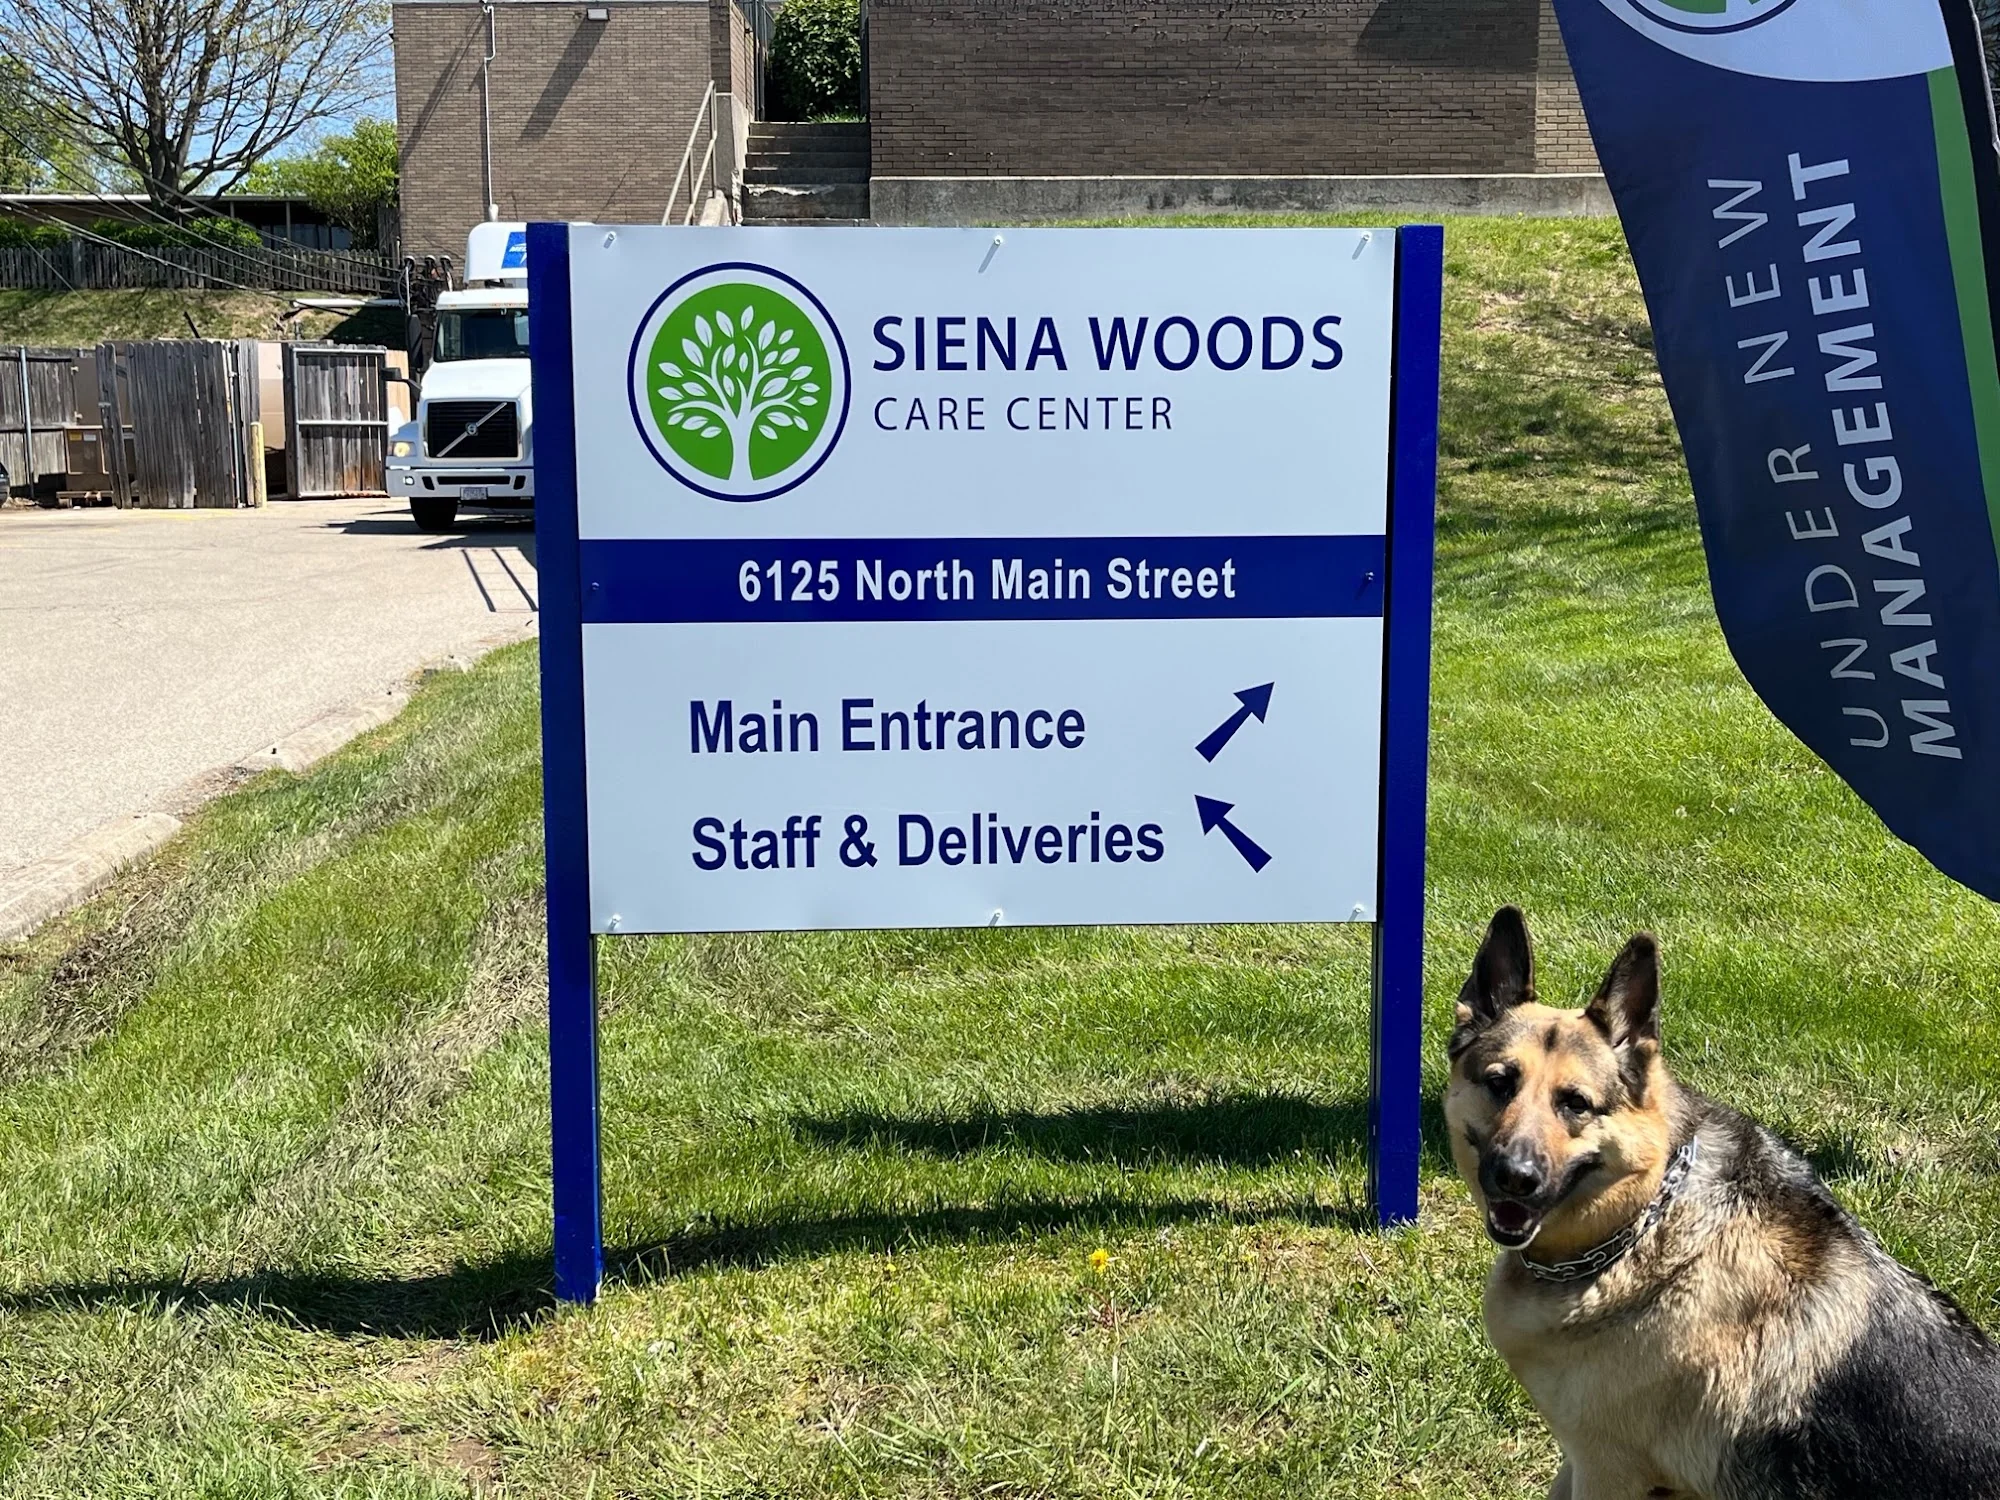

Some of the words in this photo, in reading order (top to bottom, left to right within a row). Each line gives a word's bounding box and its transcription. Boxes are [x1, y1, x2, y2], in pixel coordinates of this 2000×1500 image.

[1707, 178, 1796, 385] NEW
[872, 315, 1068, 372] SIENA
[1087, 315, 1343, 372] WOODS
[874, 396, 985, 431] CARE
[1006, 396, 1172, 431] CENTER
[1787, 152, 1963, 760] MANAGEMENT
[739, 559, 840, 602] 6125
[856, 559, 974, 601] North
[992, 558, 1090, 600] Main
[1106, 557, 1237, 599] Street
[1767, 443, 1889, 749] UNDER
[689, 699, 819, 754] Main
[841, 698, 1086, 752] Entrance
[691, 814, 822, 871] Staff
[839, 814, 878, 868] &
[898, 811, 1165, 866] Deliveries
